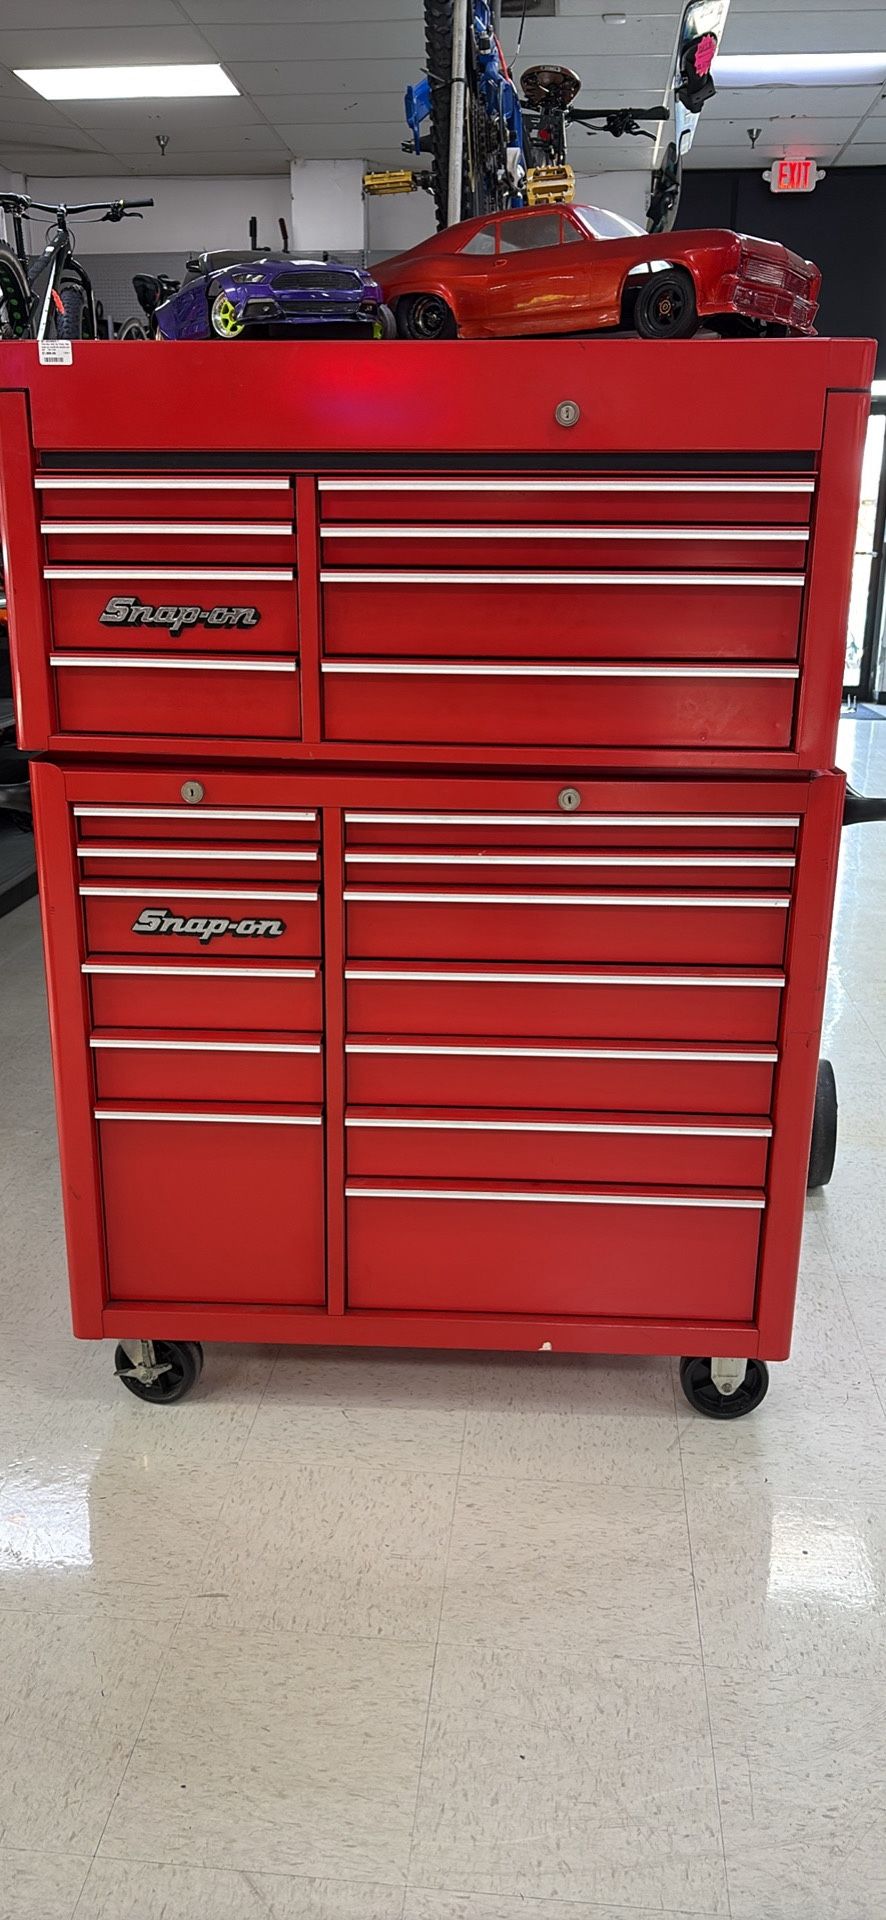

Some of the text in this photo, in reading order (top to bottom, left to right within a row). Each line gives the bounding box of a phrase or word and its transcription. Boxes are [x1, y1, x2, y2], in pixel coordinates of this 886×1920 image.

[778, 162, 812, 189] EXIT
[99, 597, 259, 633] Snap-on
[132, 909, 284, 940] Snap-on
